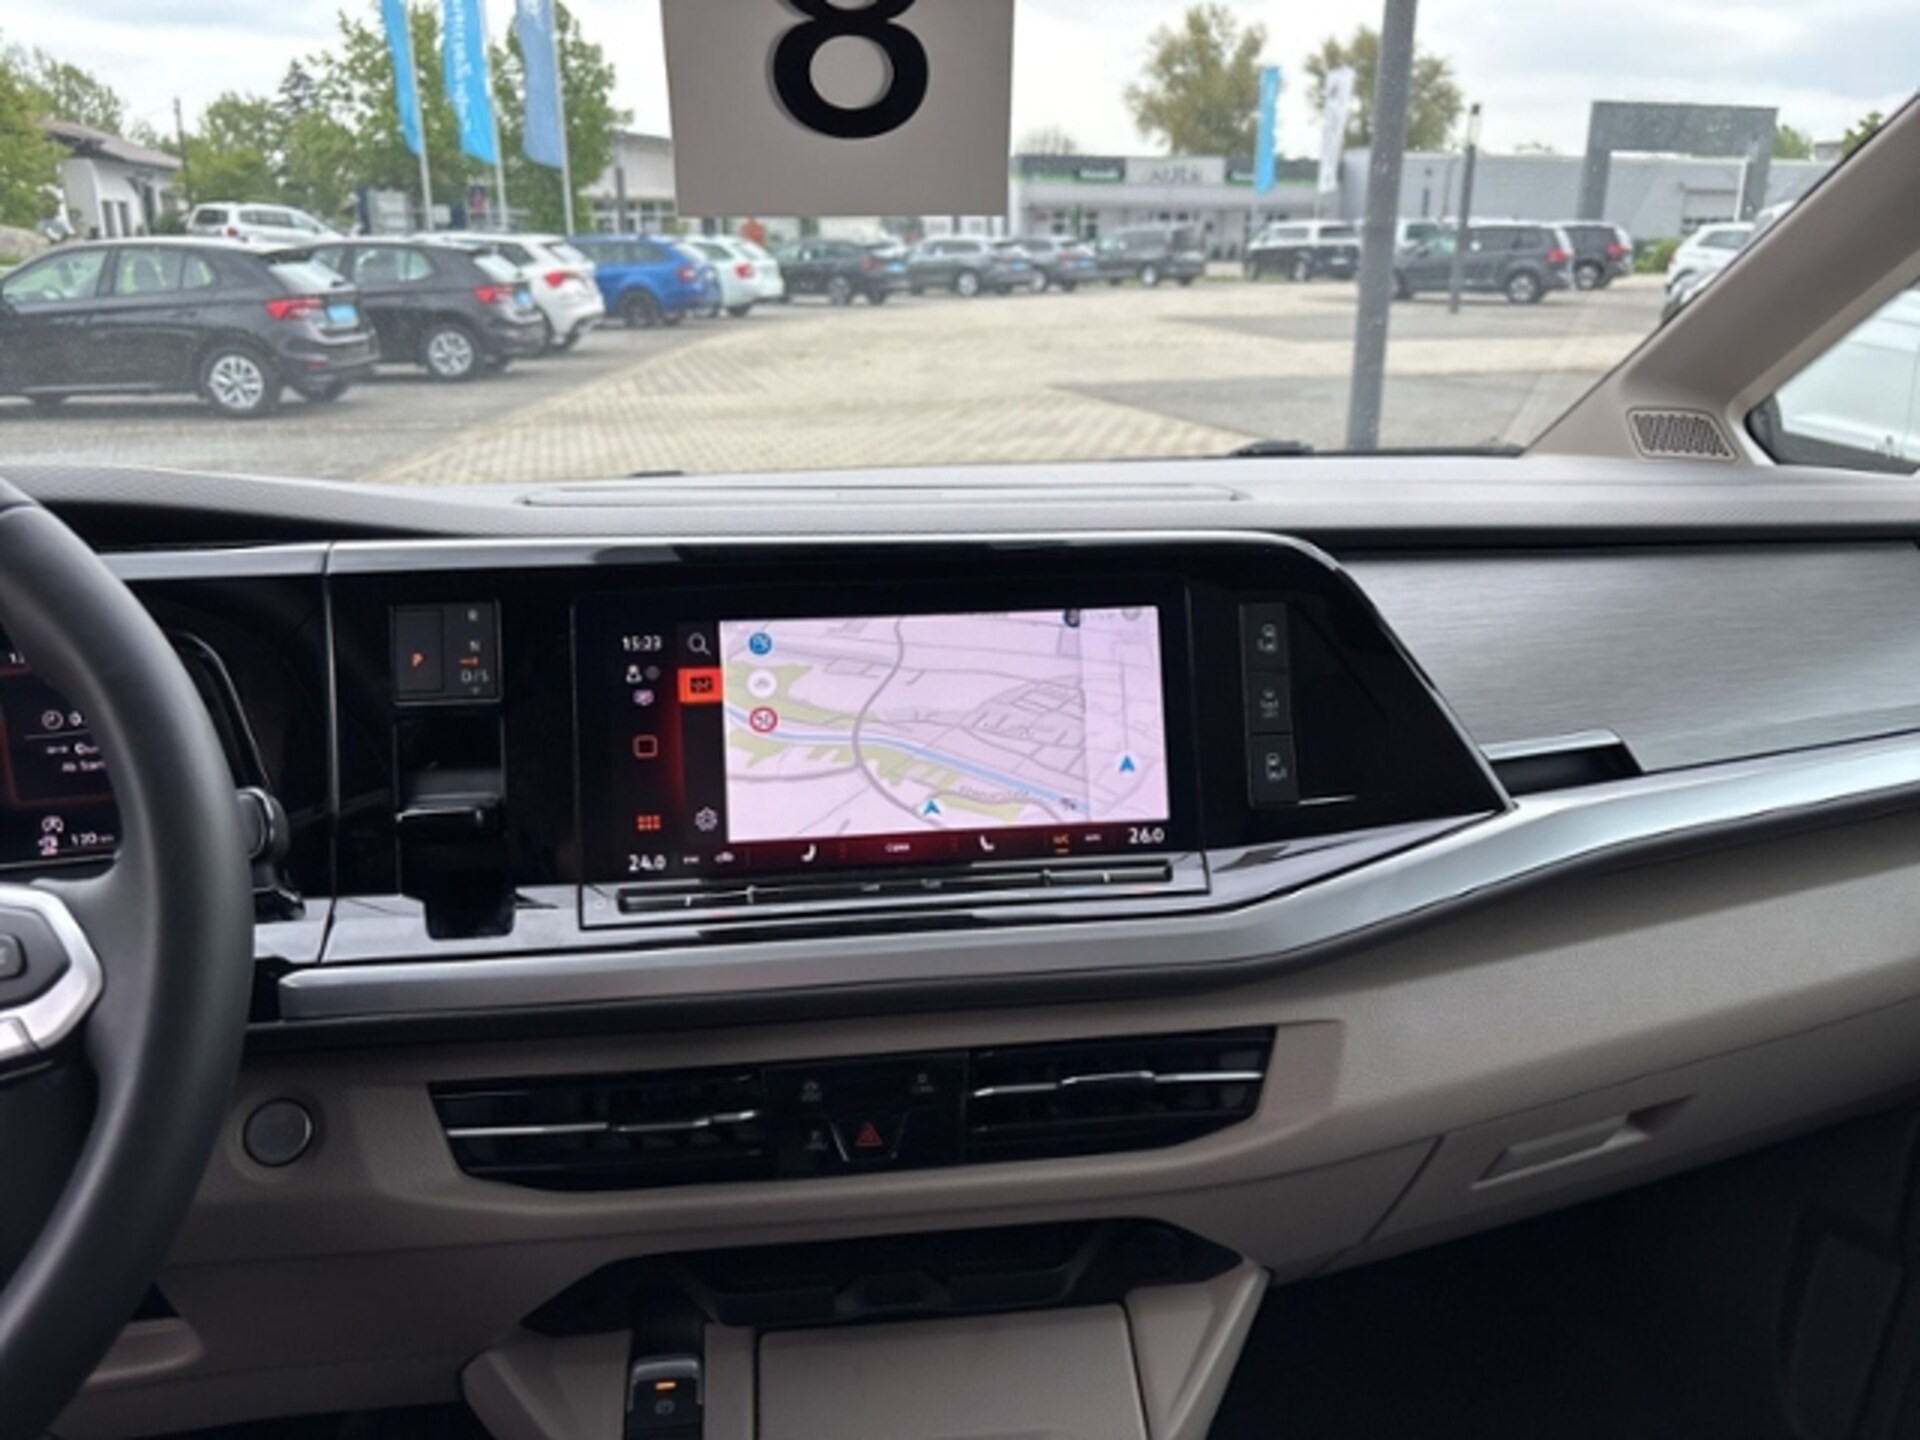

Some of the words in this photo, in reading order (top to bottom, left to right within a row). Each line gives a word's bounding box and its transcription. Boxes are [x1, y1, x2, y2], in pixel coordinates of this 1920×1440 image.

[770, 0, 930, 139] 8
[622, 634, 662, 652] 15:23
[1127, 826, 1165, 845] 26.0
[628, 854, 667, 872] 24.0
